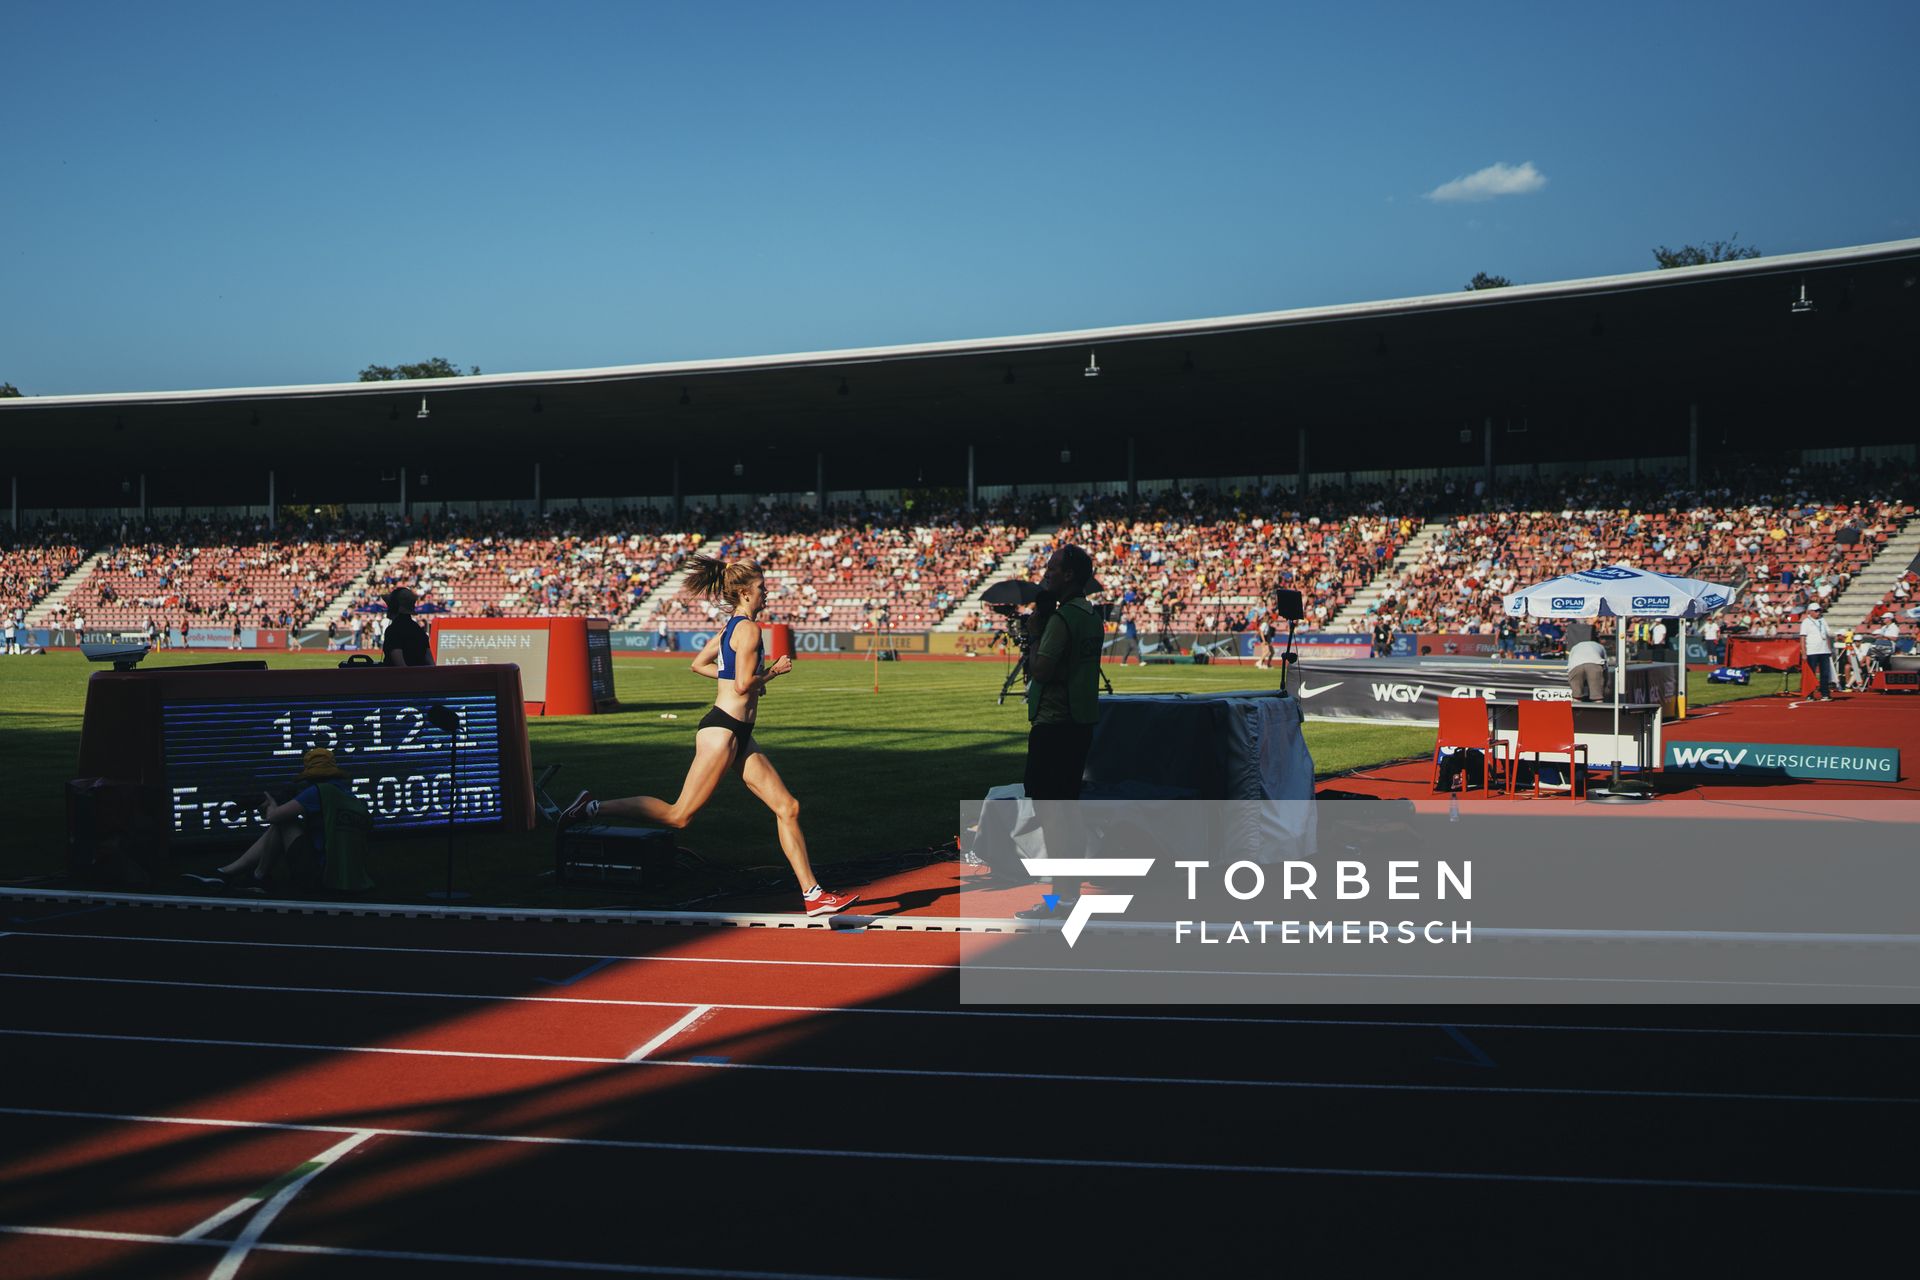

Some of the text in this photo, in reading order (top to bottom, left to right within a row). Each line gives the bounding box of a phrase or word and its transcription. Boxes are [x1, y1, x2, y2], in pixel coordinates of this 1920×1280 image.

[440, 634, 531, 649] RENSMANN N
[624, 636, 650, 647] WGV
[794, 633, 841, 652] ZOLL
[1476, 643, 1499, 653] FINAL
[1372, 683, 1424, 702] WGV
[1553, 691, 1573, 699] PLA
[1673, 747, 1891, 771] WGV VERSICHERUNG
[352, 773, 495, 819] 5000m
